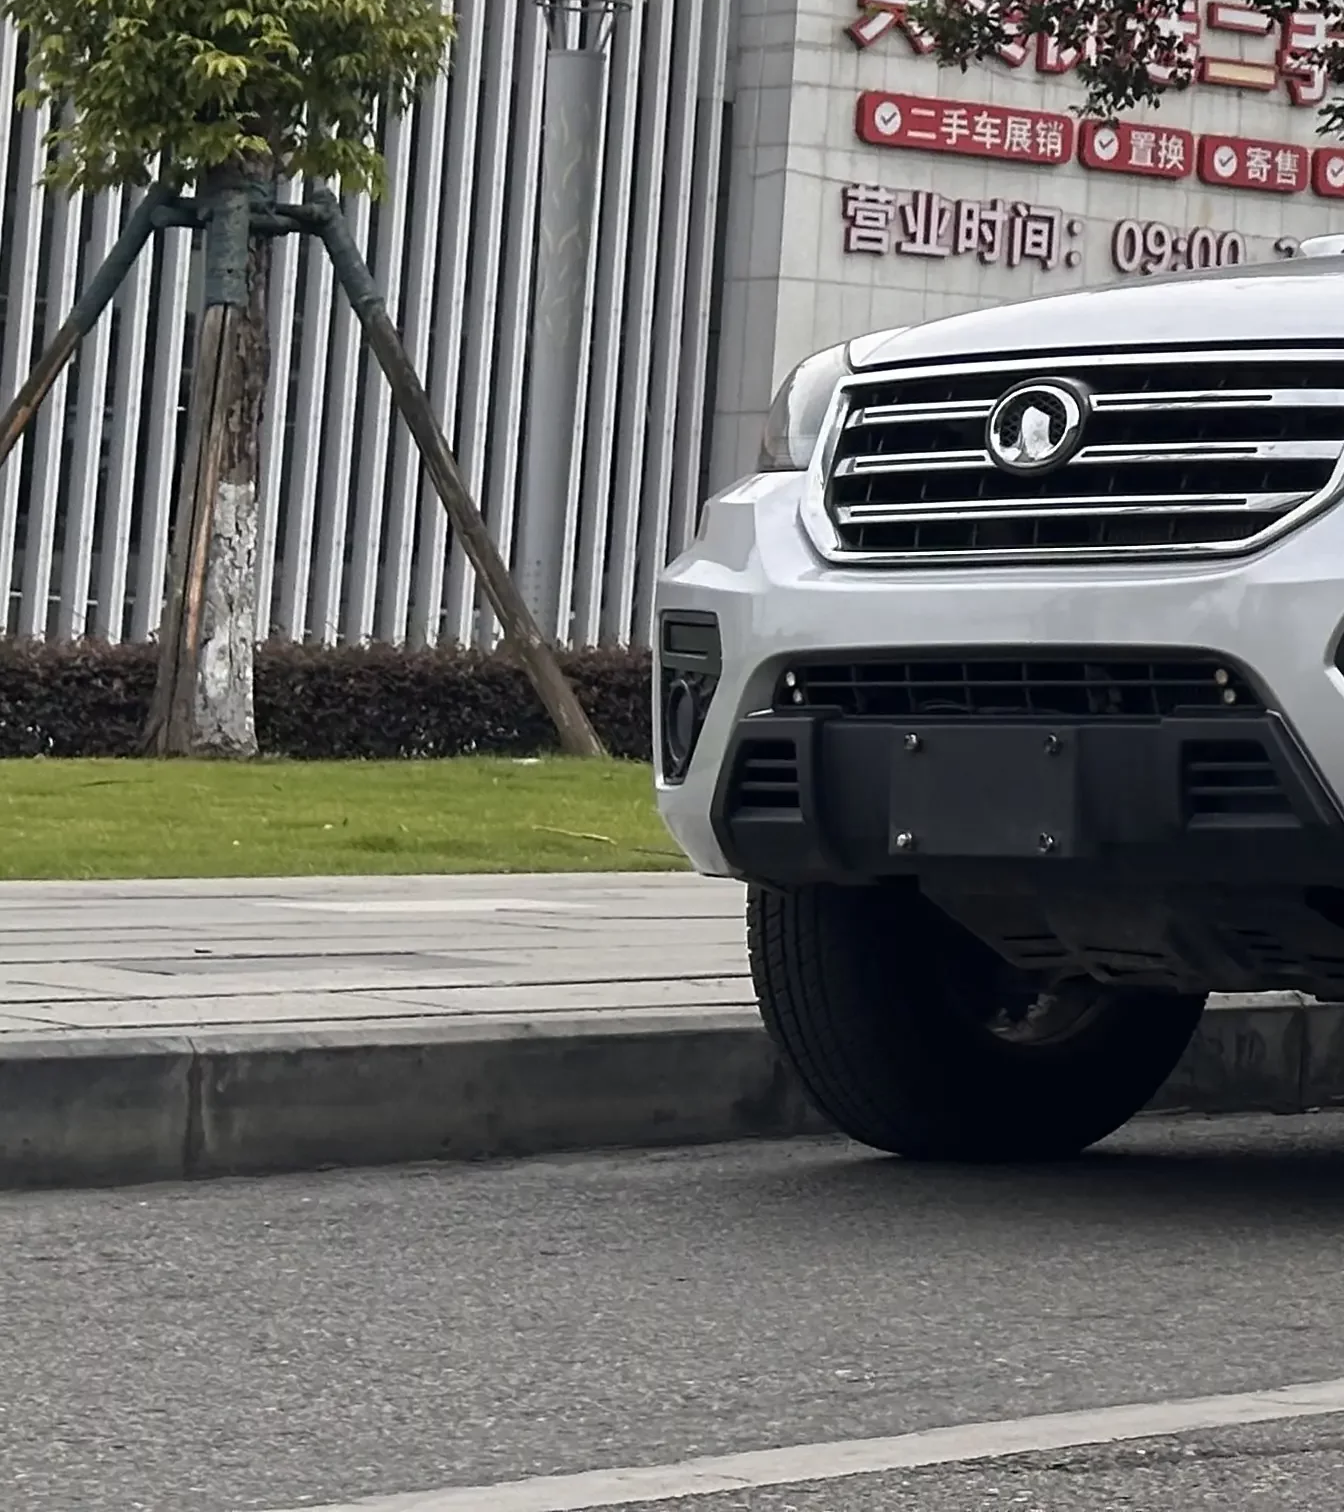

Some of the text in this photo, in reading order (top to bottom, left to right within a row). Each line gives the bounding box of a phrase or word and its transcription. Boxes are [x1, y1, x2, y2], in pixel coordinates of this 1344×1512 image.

[906, 106, 1065, 158] 二手车展销
[1127, 130, 1185, 172] 置换
[1246, 147, 1300, 186] 寄售
